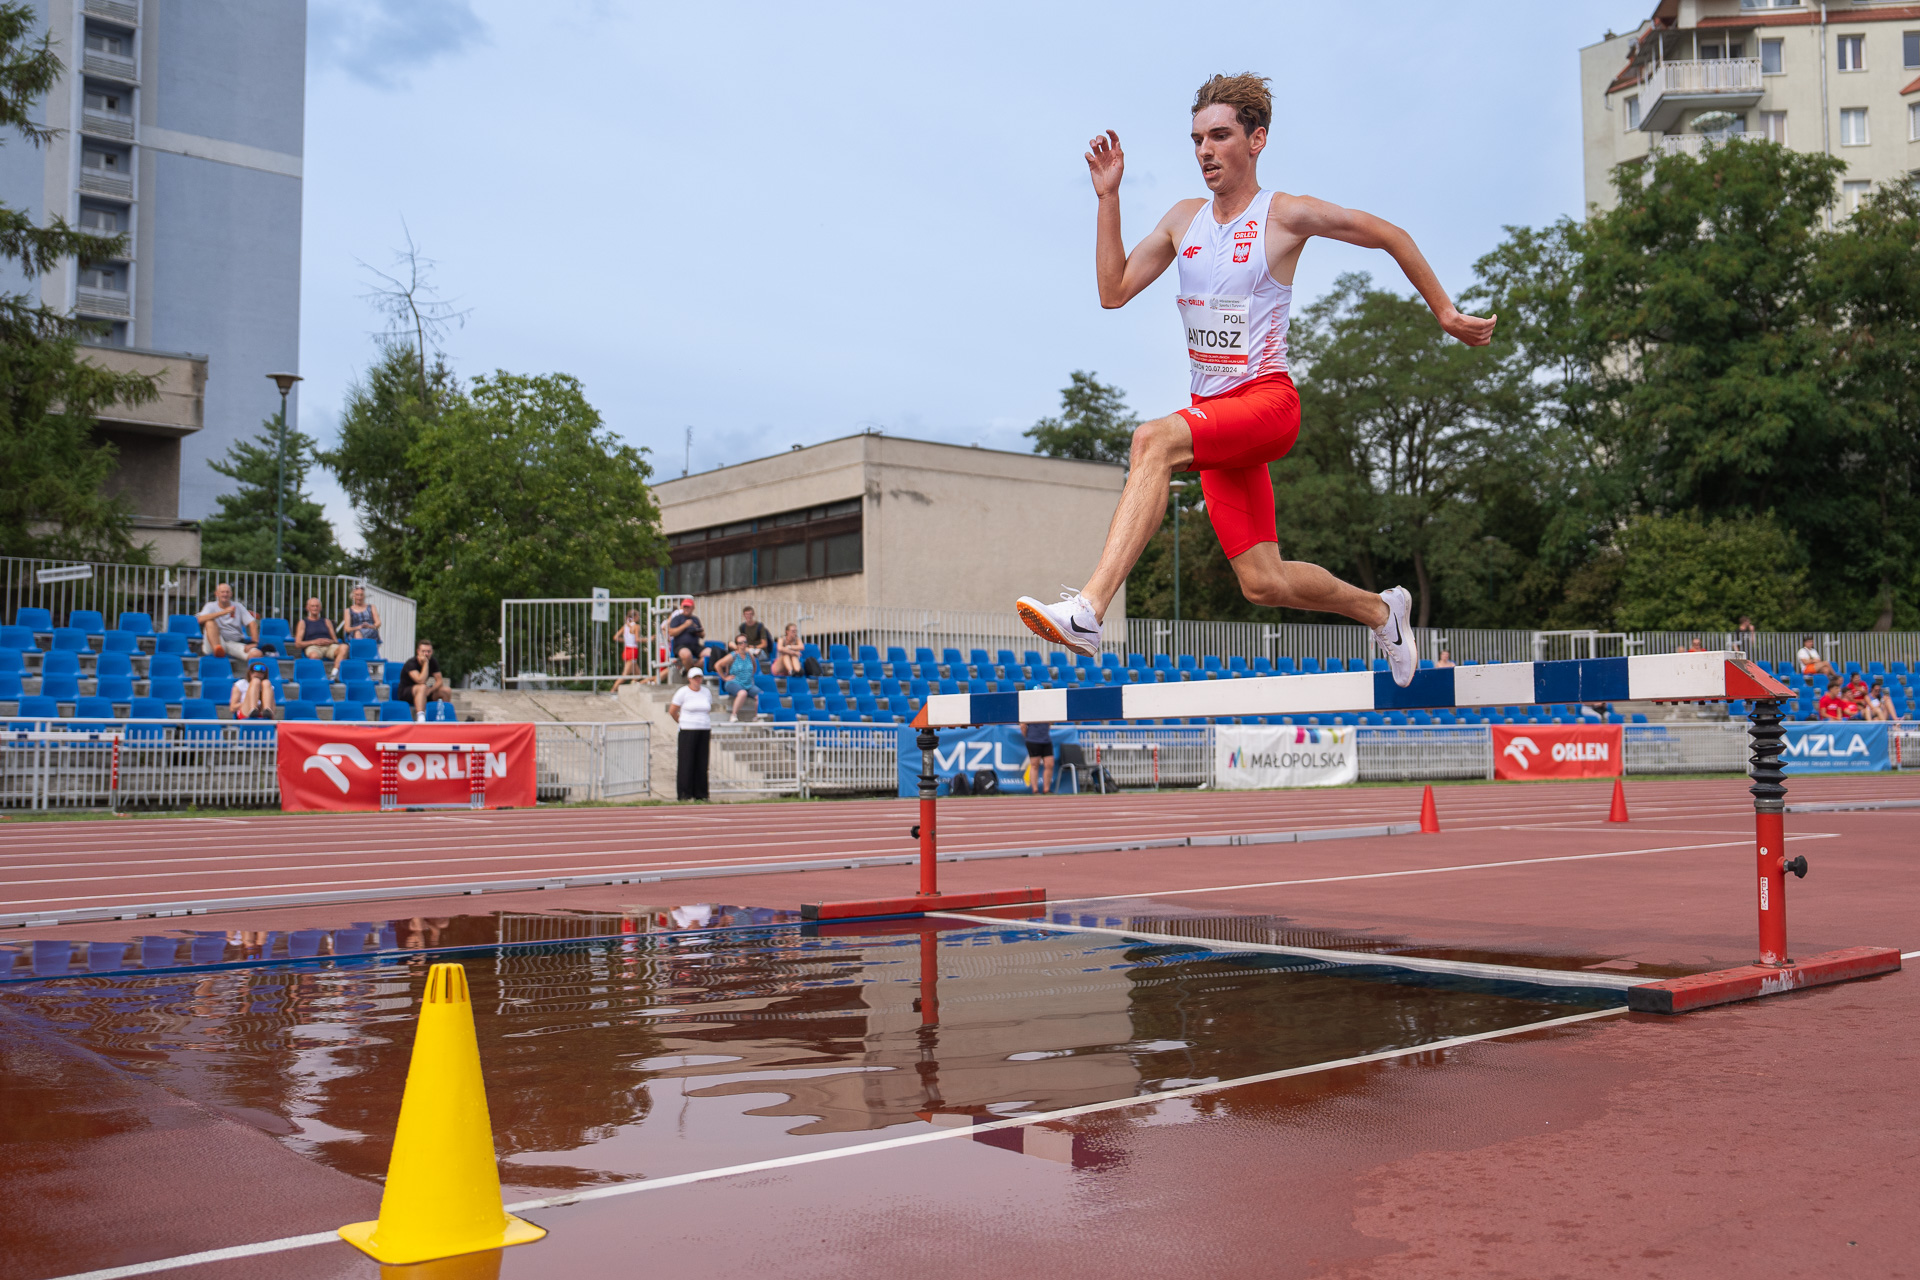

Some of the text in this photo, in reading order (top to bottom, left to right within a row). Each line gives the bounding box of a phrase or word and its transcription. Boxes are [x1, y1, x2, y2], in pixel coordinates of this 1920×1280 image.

[1235, 231, 1257, 239] ORLEN
[1182, 245, 1203, 259] 4F
[1223, 314, 1246, 324] POL
[1188, 327, 1242, 349] ANTOSZ
[1205, 365, 1238, 373] 20.07.2024
[1551, 742, 1609, 762] ORLEN
[1781, 733, 1870, 757] MZLA
[1250, 752, 1347, 769] MAŁOPOLSKA
